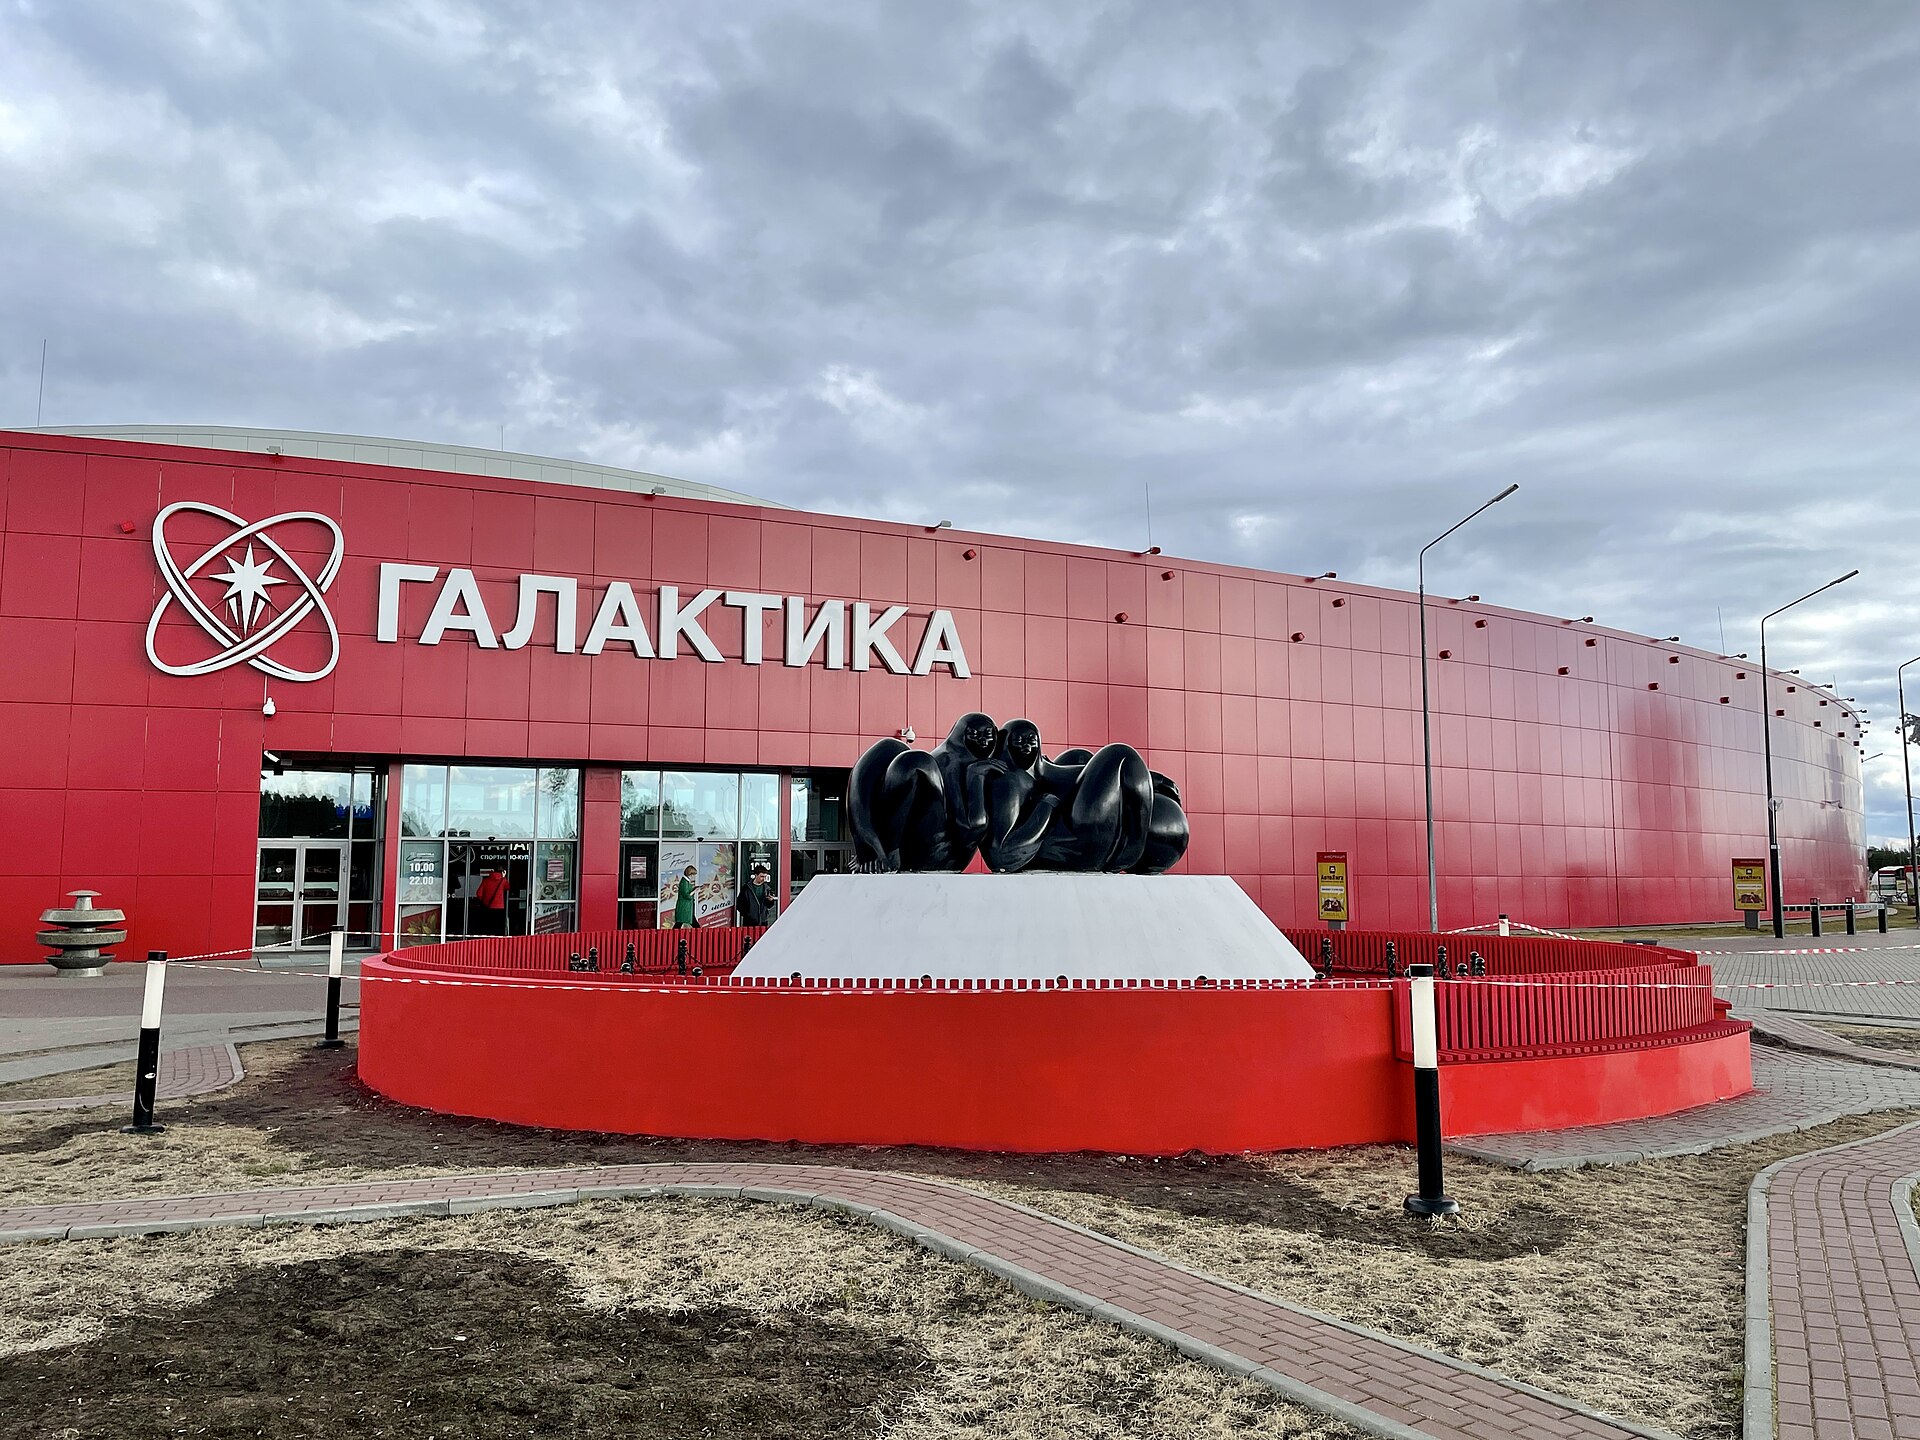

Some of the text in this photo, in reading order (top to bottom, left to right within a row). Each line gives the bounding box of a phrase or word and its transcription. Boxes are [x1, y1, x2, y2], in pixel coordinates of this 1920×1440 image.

[376, 562, 972, 679] ГАЛАКТИКА
[409, 863, 435, 872] 10.00
[409, 876, 434, 885] 22.00
